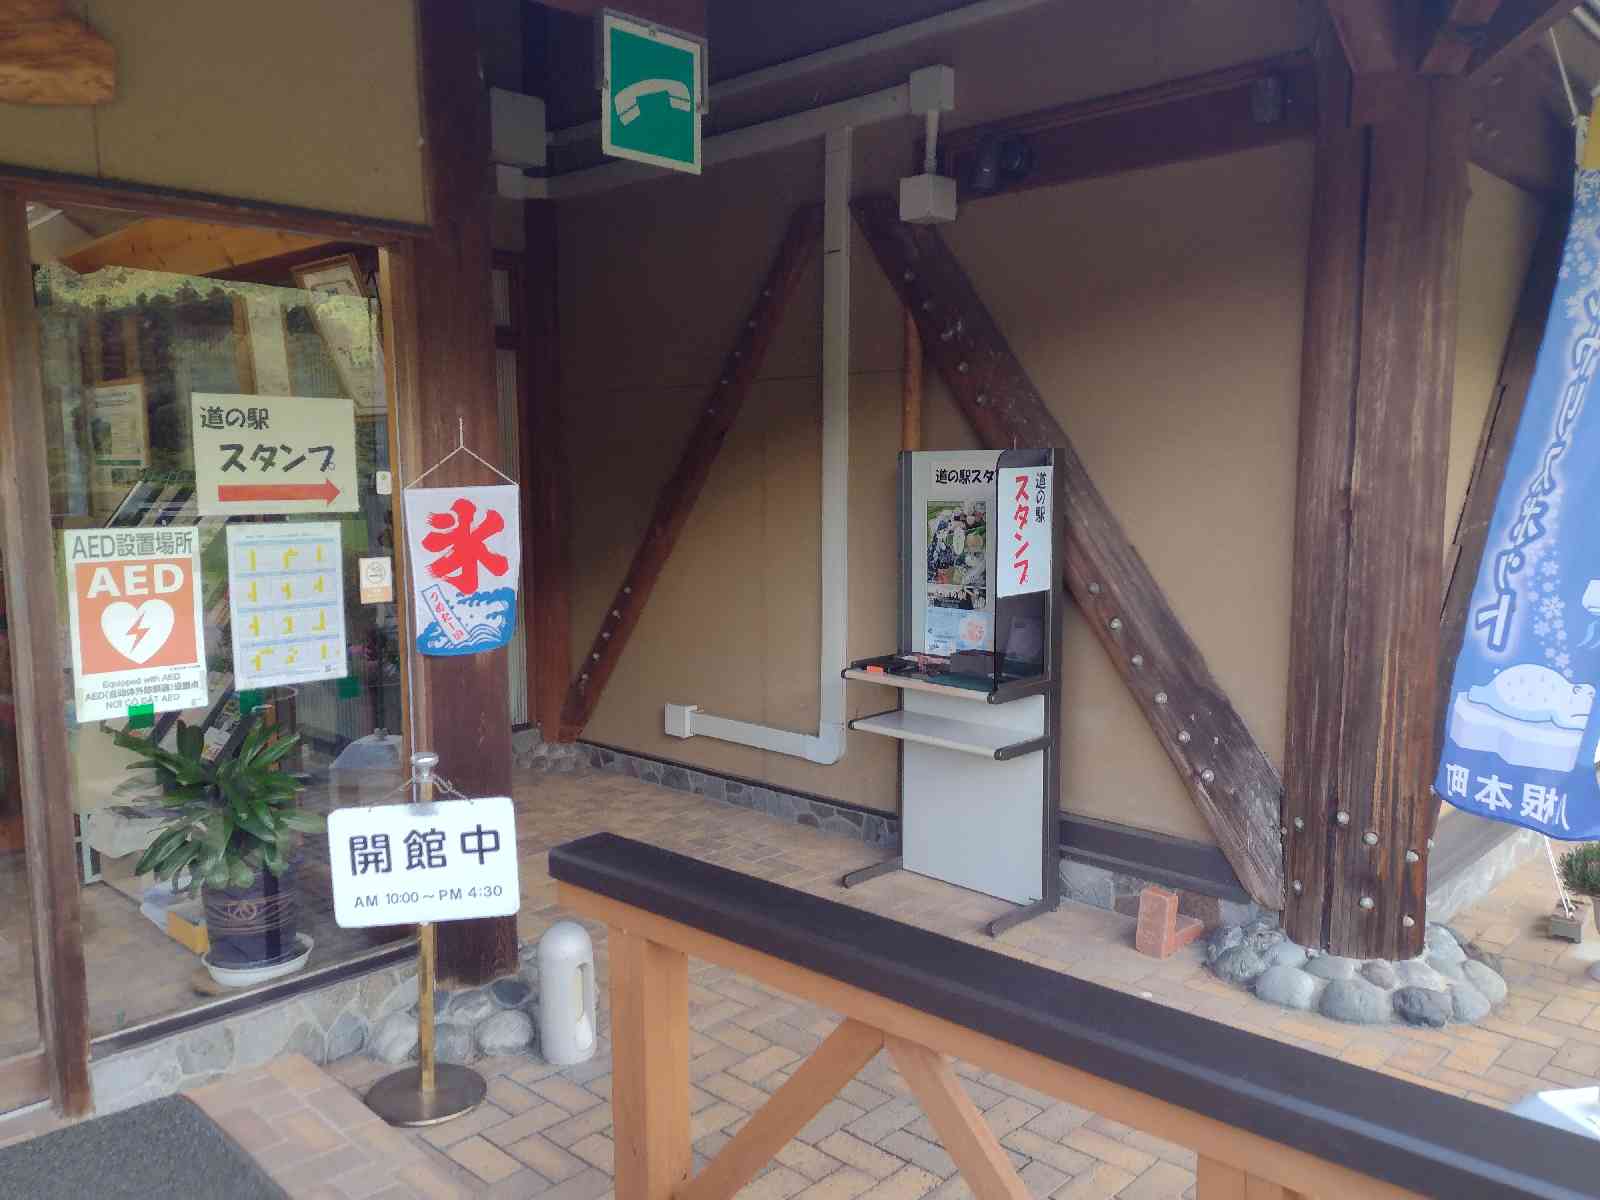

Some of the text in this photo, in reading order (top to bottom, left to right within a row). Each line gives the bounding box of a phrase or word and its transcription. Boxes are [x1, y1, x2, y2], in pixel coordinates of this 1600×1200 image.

[199, 405, 270, 430] 道の駅
[220, 443, 336, 472] スタンプ
[936, 469, 995, 485] 道の駅スタ
[1034, 471, 1047, 523] 道の駅
[72, 530, 193, 559] AED設置場所
[1013, 475, 1030, 585] スタンプ
[421, 498, 509, 595] 氷
[86, 563, 184, 598] AED
[349, 823, 501, 876] 開館中
[354, 895, 379, 908] AM
[467, 885, 503, 898] 4:30
